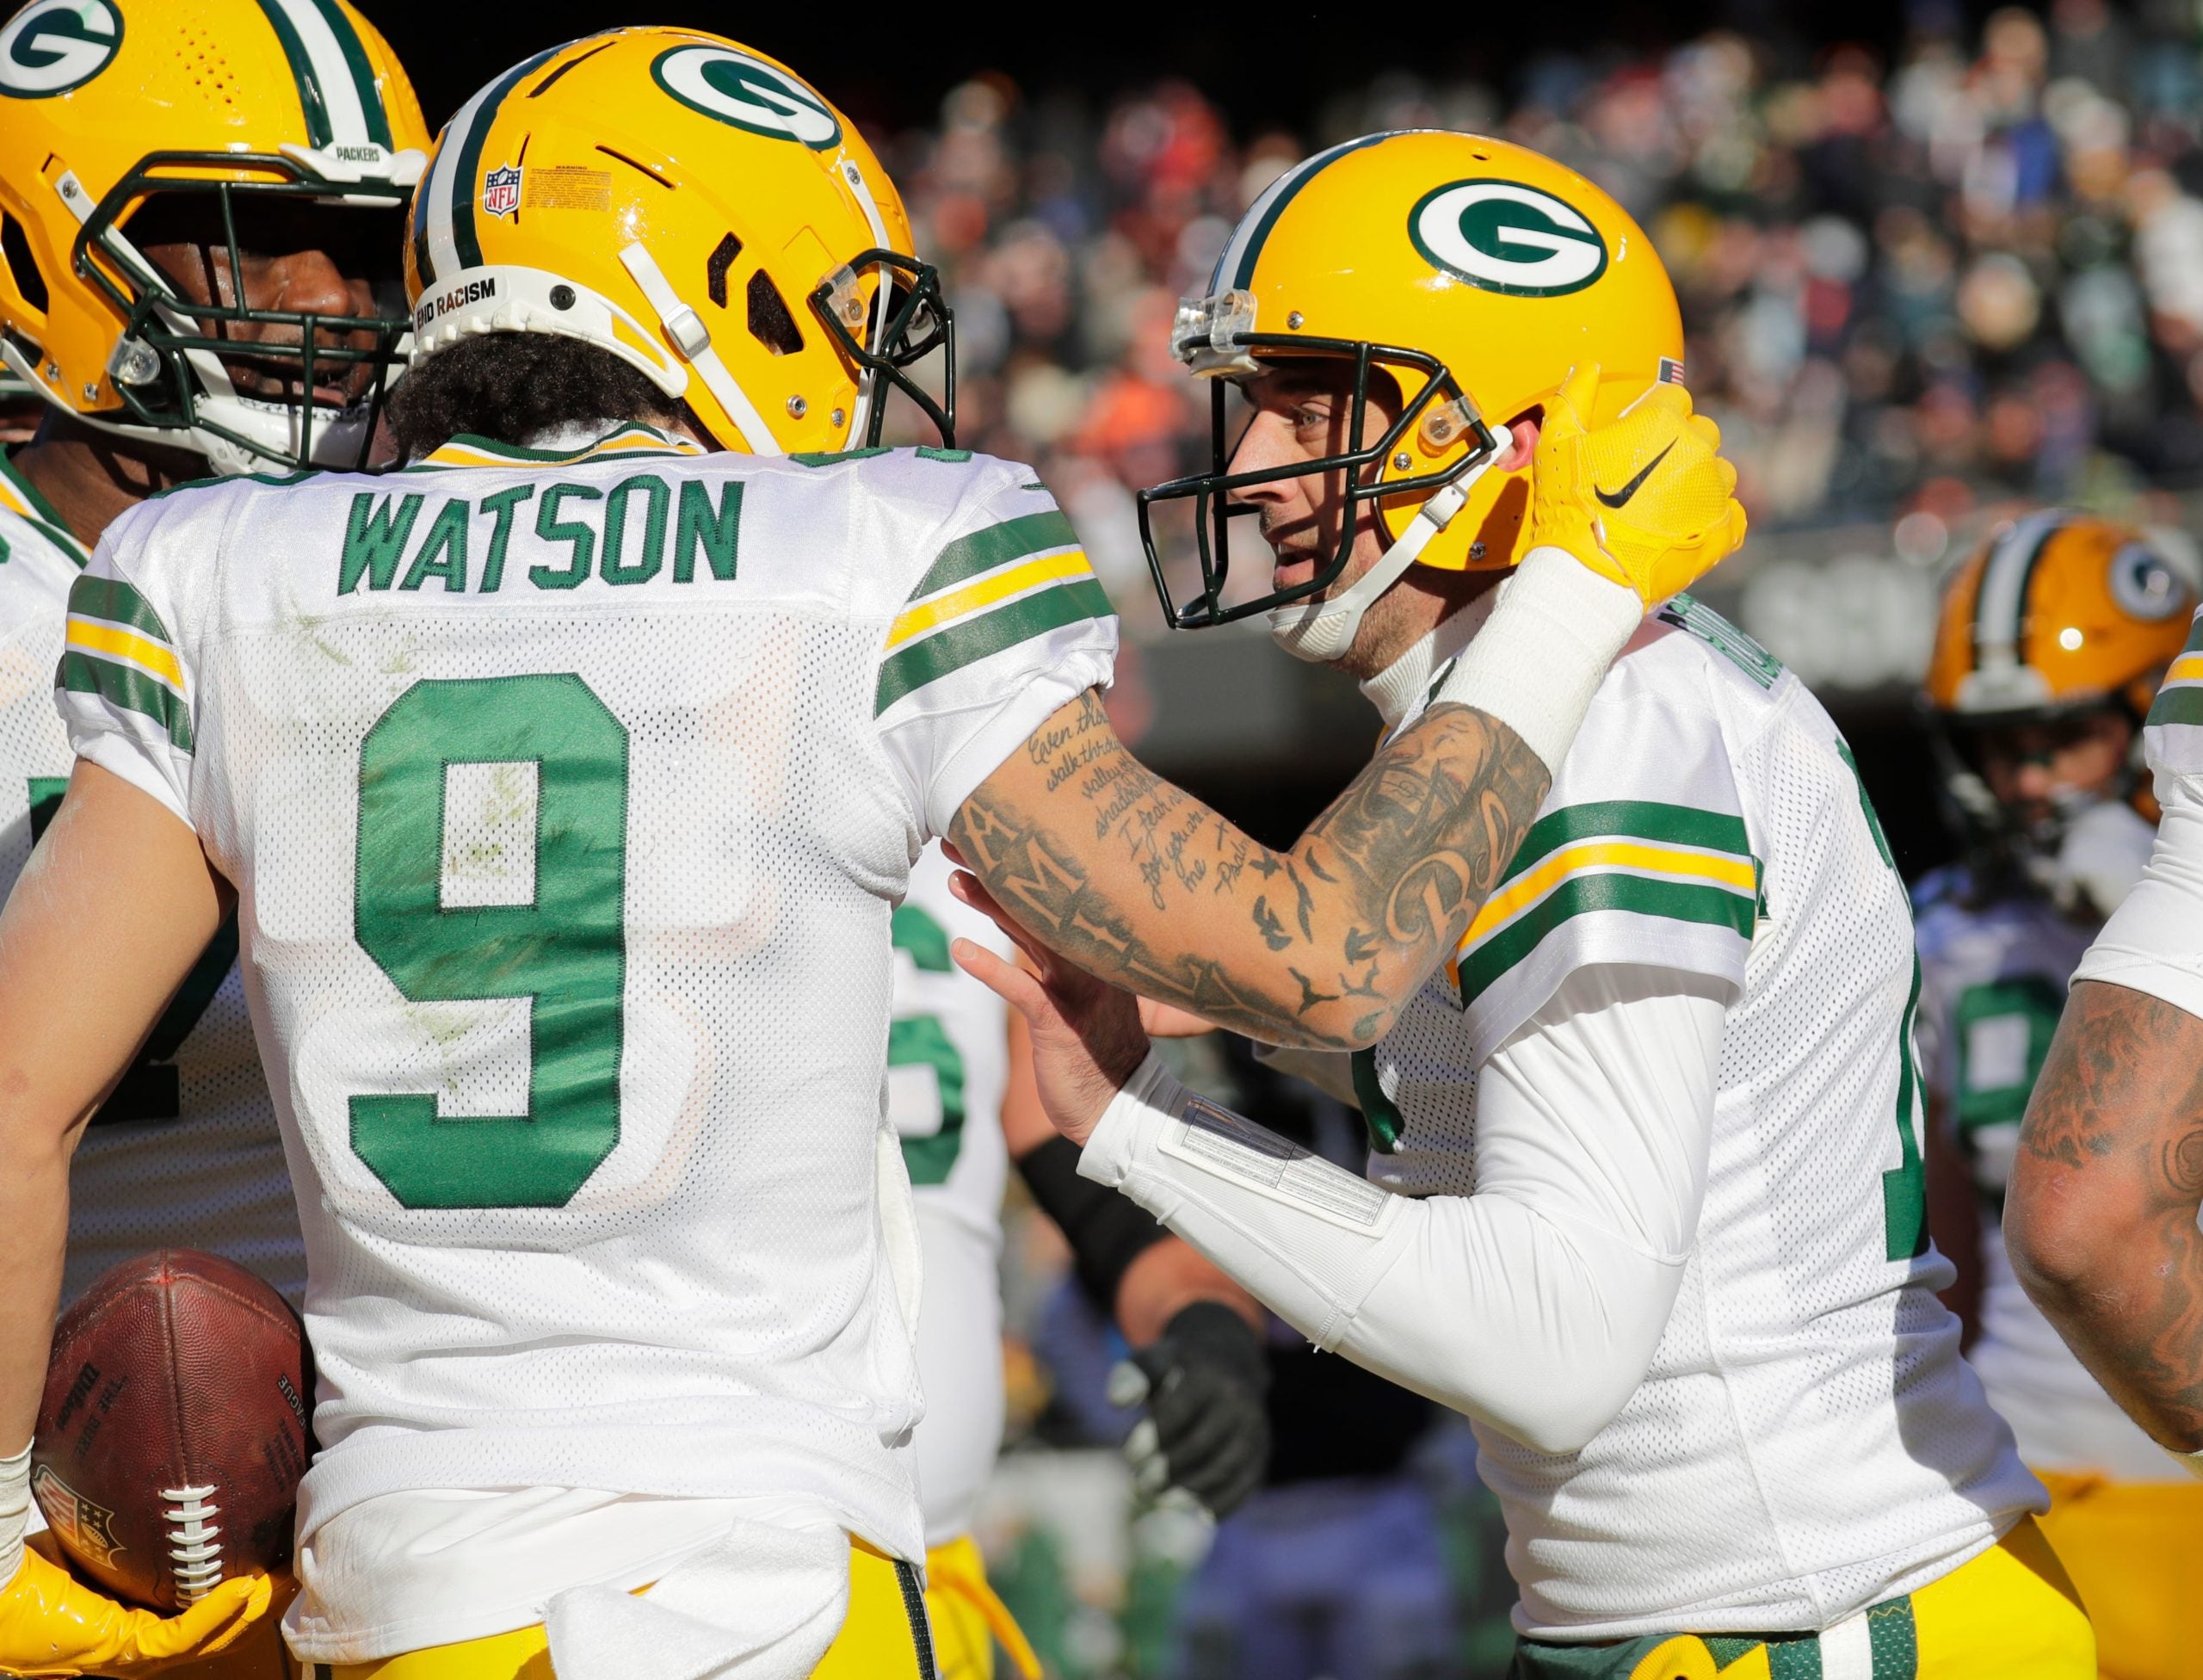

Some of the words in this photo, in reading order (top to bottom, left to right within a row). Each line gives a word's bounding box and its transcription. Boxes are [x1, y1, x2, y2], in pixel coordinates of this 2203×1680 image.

[661, 47, 836, 143] G
[336, 146, 380, 162] PACKERS
[488, 186, 515, 209] NFL
[1418, 183, 1602, 287] G
[417, 301, 434, 331] END
[436, 277, 496, 317] RACISM
[338, 474, 744, 596] WATSON
[1028, 726, 1073, 764] Even
[1047, 751, 1082, 792] walk
[1182, 859, 1206, 893] me
[349, 673, 629, 1209] 9
